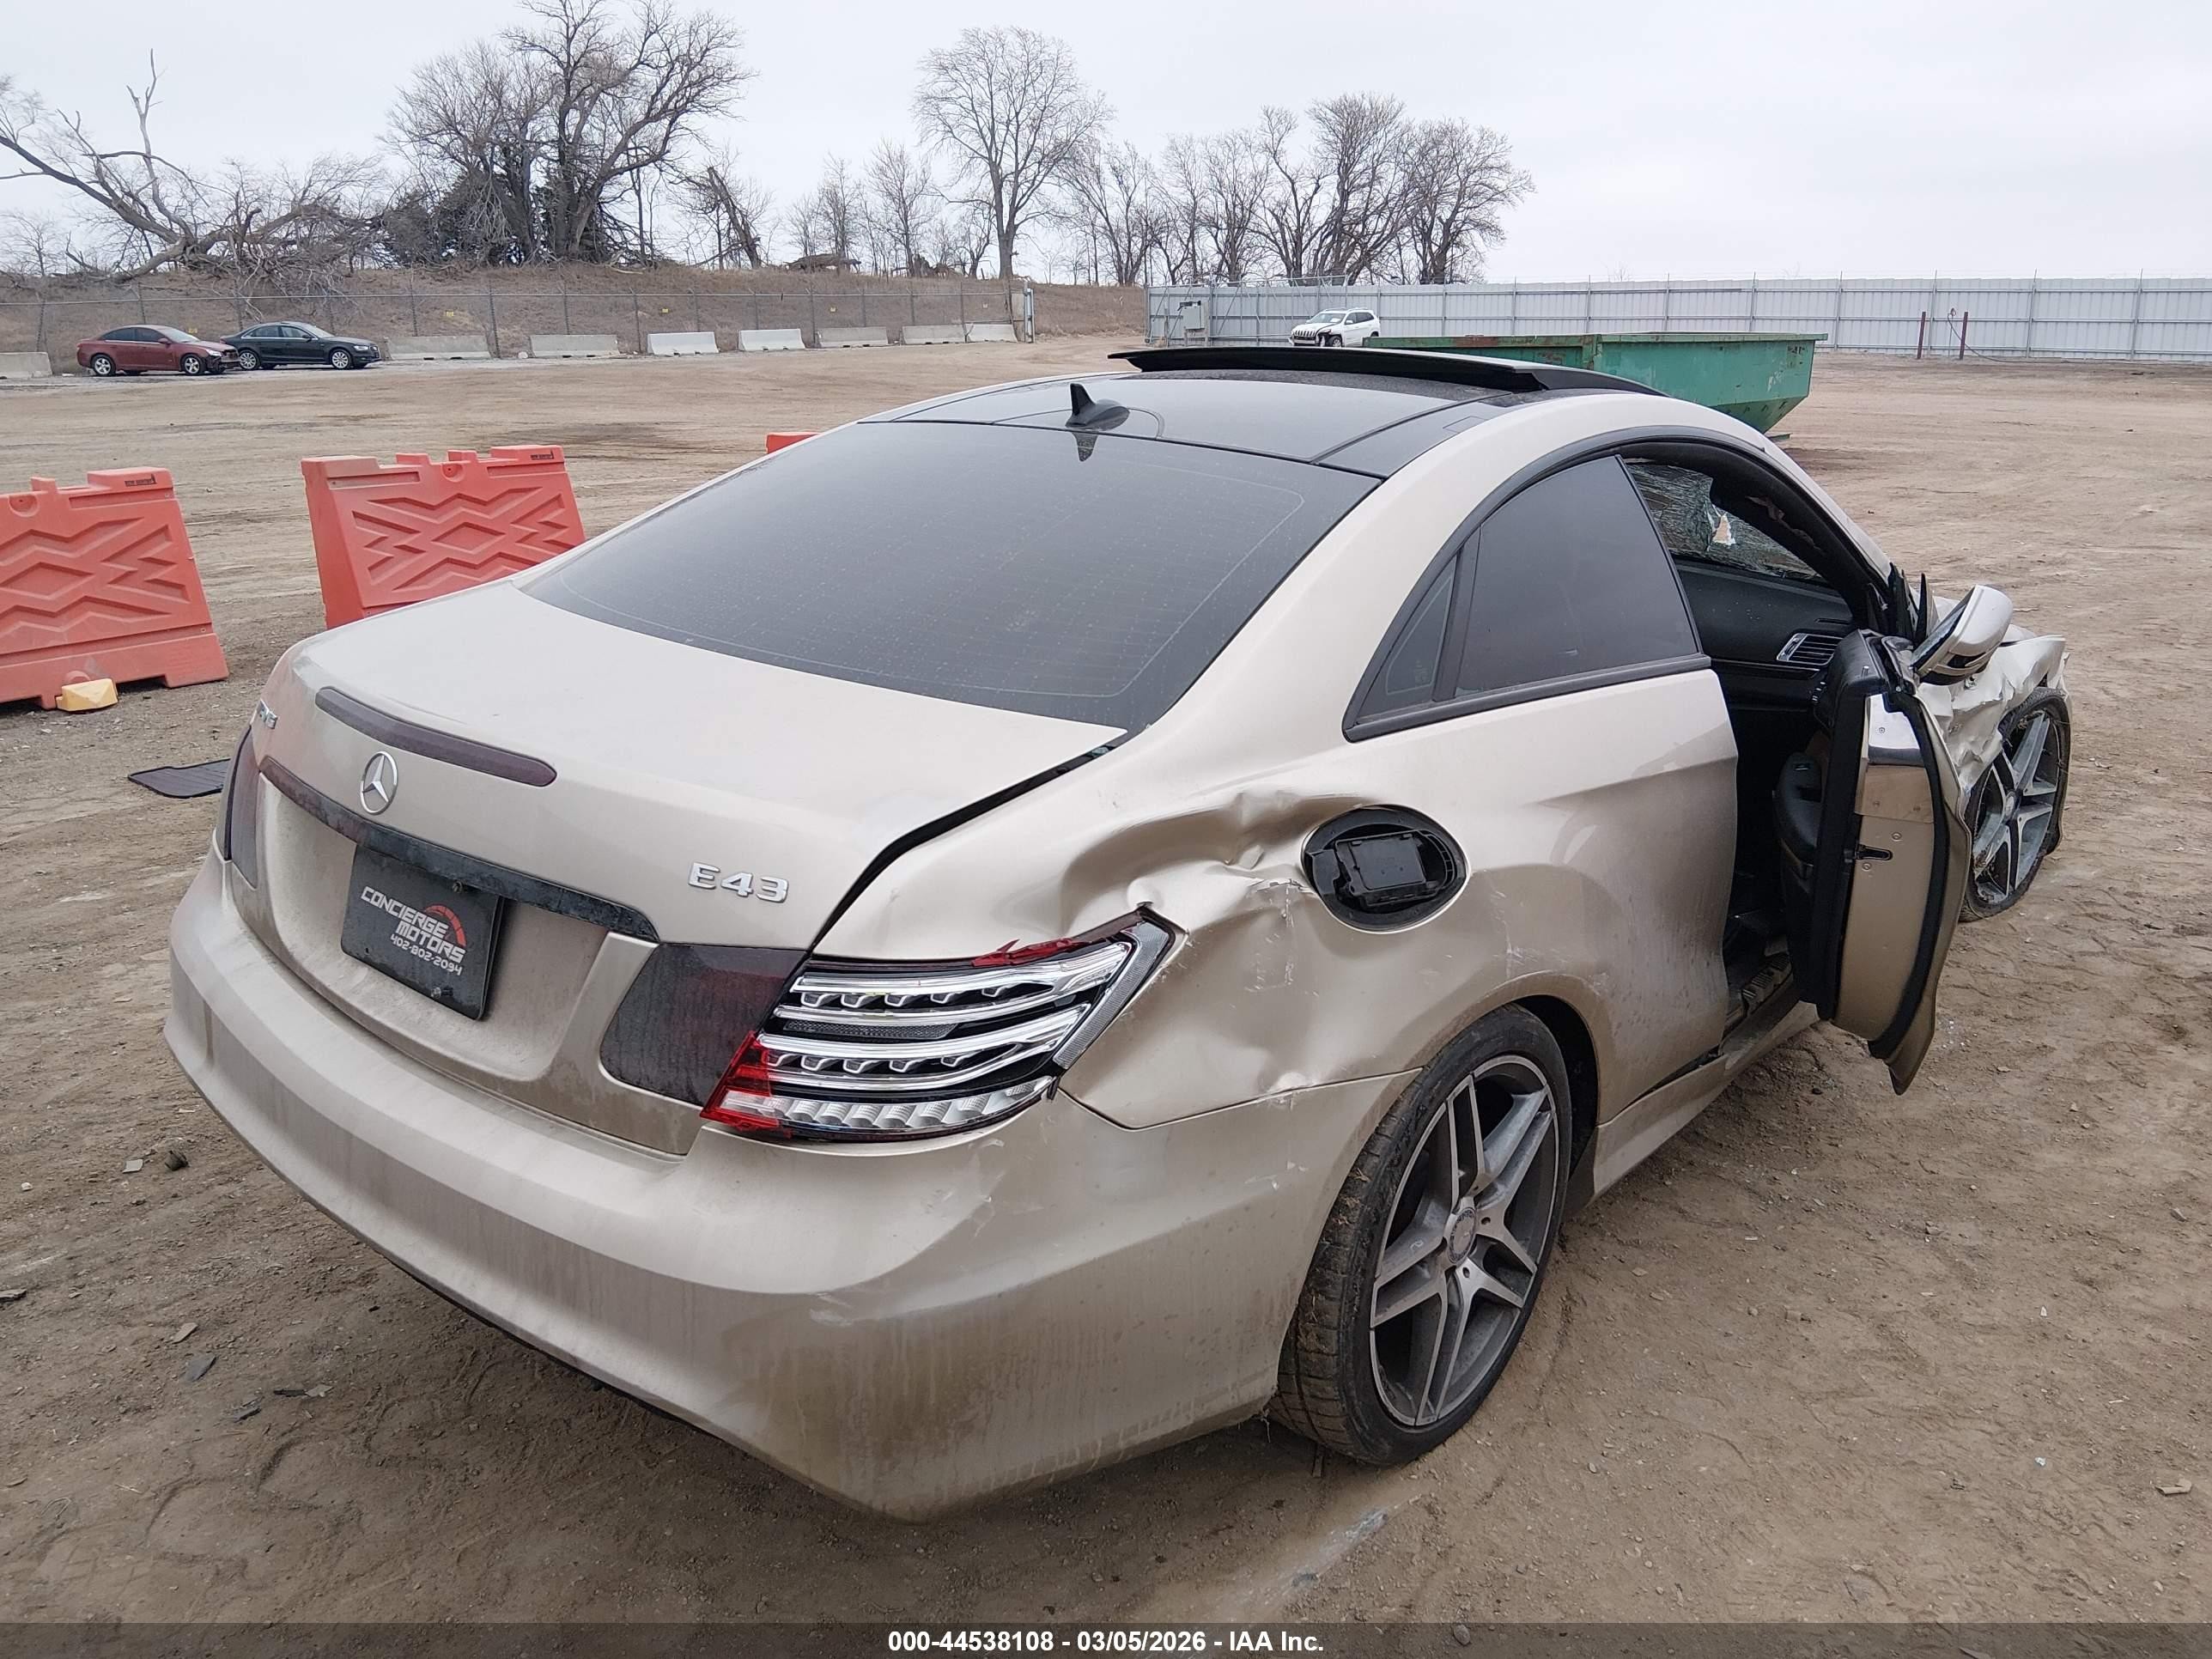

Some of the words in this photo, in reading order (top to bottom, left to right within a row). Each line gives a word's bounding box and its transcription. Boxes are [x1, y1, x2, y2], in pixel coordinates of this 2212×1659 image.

[688, 861, 788, 903] E43
[361, 886, 449, 938] CONCIERGE
[391, 933, 463, 975] 402-802-2094
[396, 921, 465, 963] MOTORS
